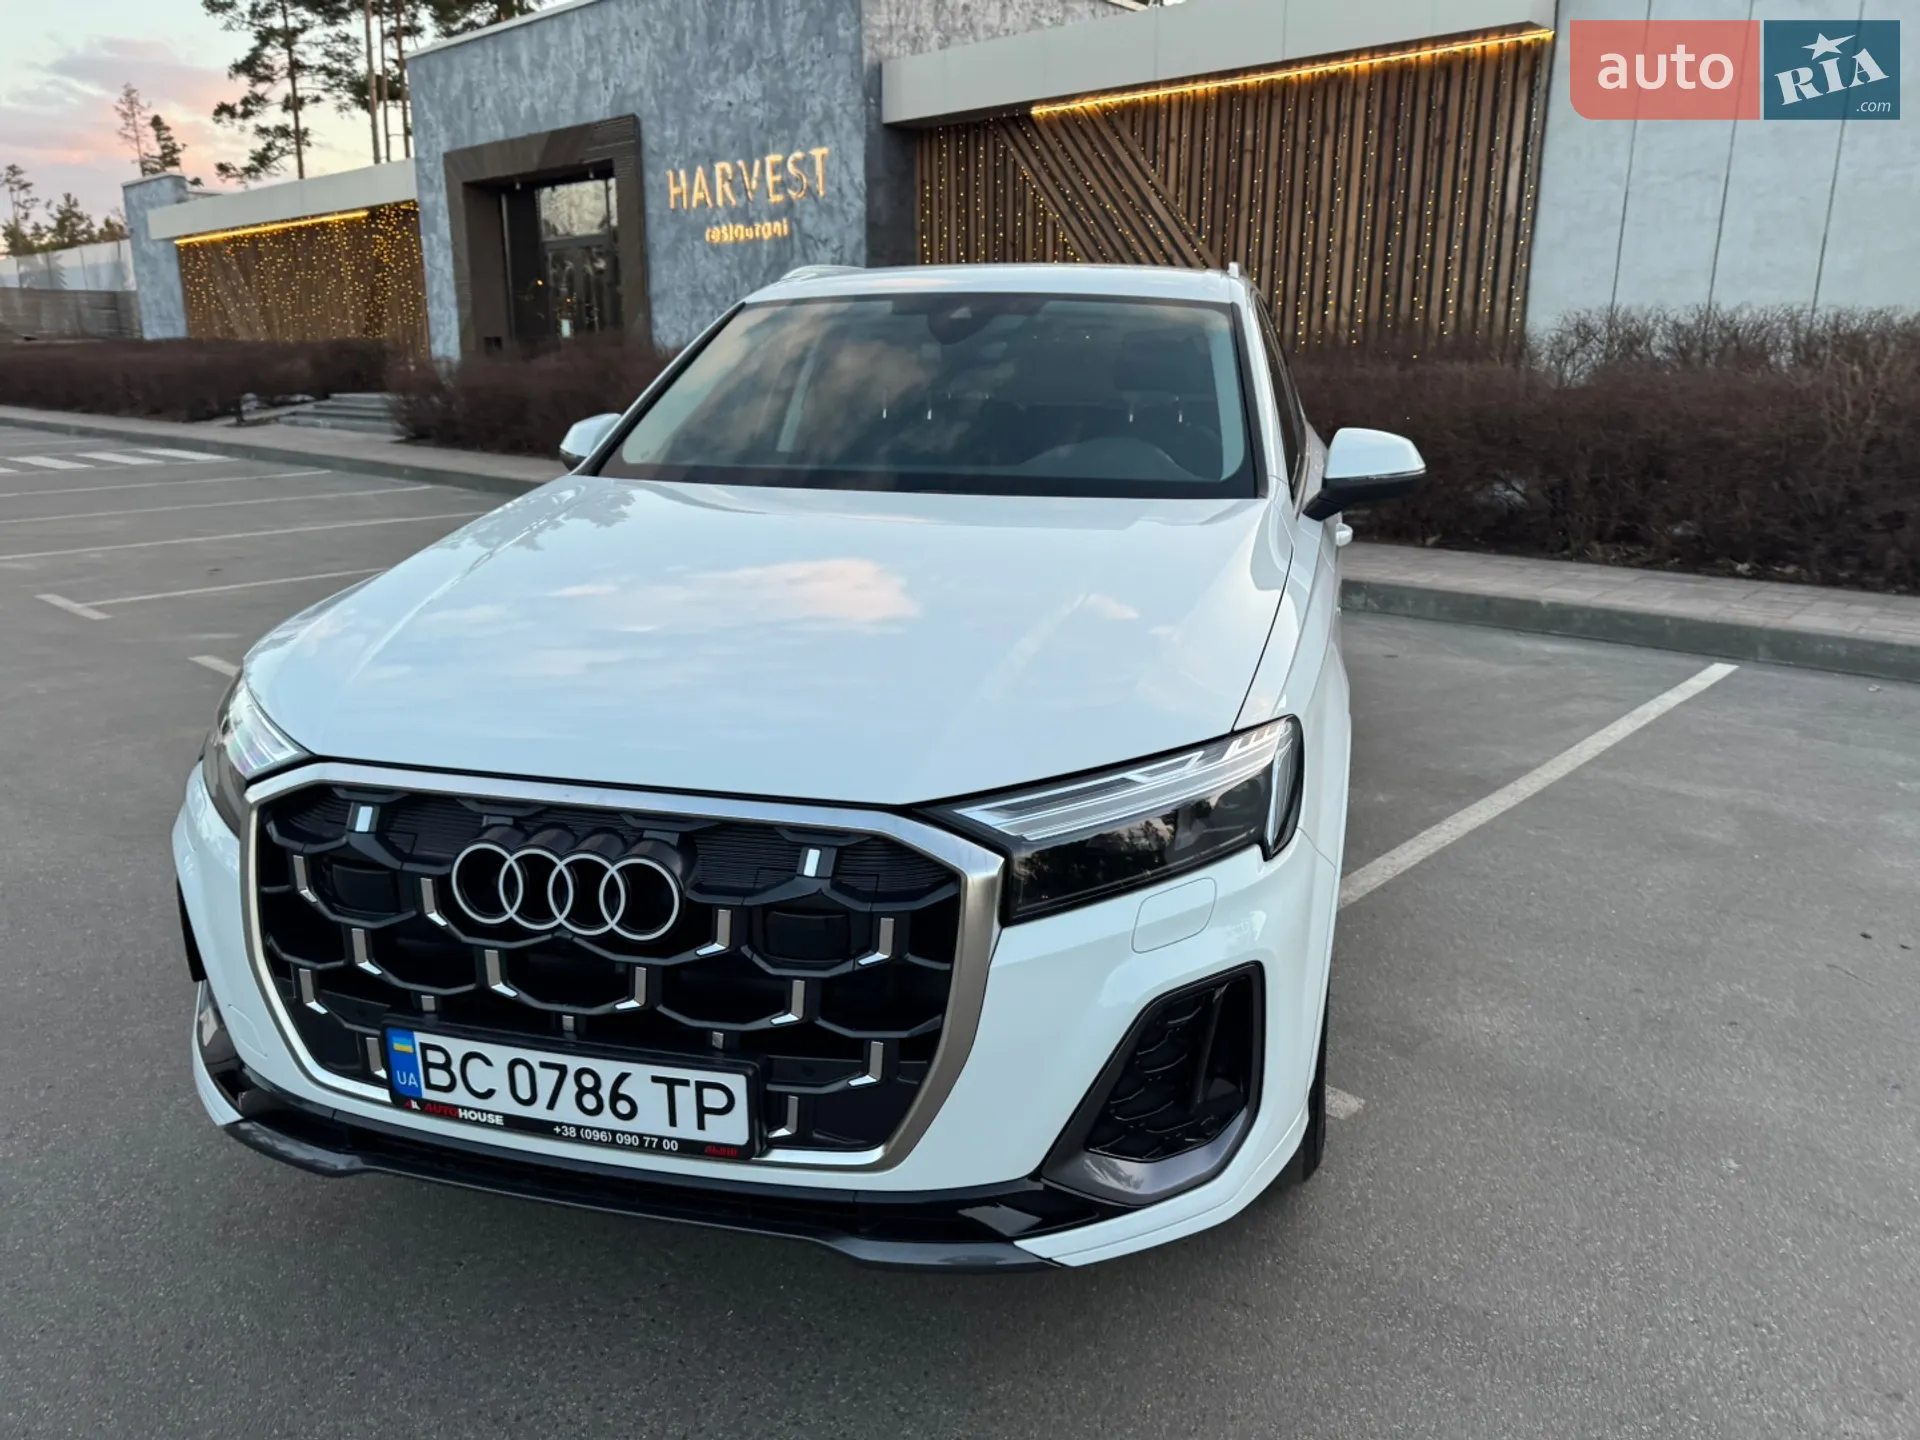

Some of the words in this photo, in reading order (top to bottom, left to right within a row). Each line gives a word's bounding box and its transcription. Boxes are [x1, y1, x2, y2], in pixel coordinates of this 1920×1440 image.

[667, 147, 830, 211] HARVEST
[395, 1069, 419, 1089] UA
[418, 1041, 497, 1100] BC
[506, 1056, 639, 1122] 0786
[650, 1074, 737, 1132] TP
[424, 1102, 505, 1126] AUTOHOUSE
[553, 1125, 577, 1138] +38
[580, 1127, 612, 1143] (096)
[615, 1133, 640, 1147] 090
[642, 1136, 659, 1149] 77
[662, 1138, 679, 1151] 00
